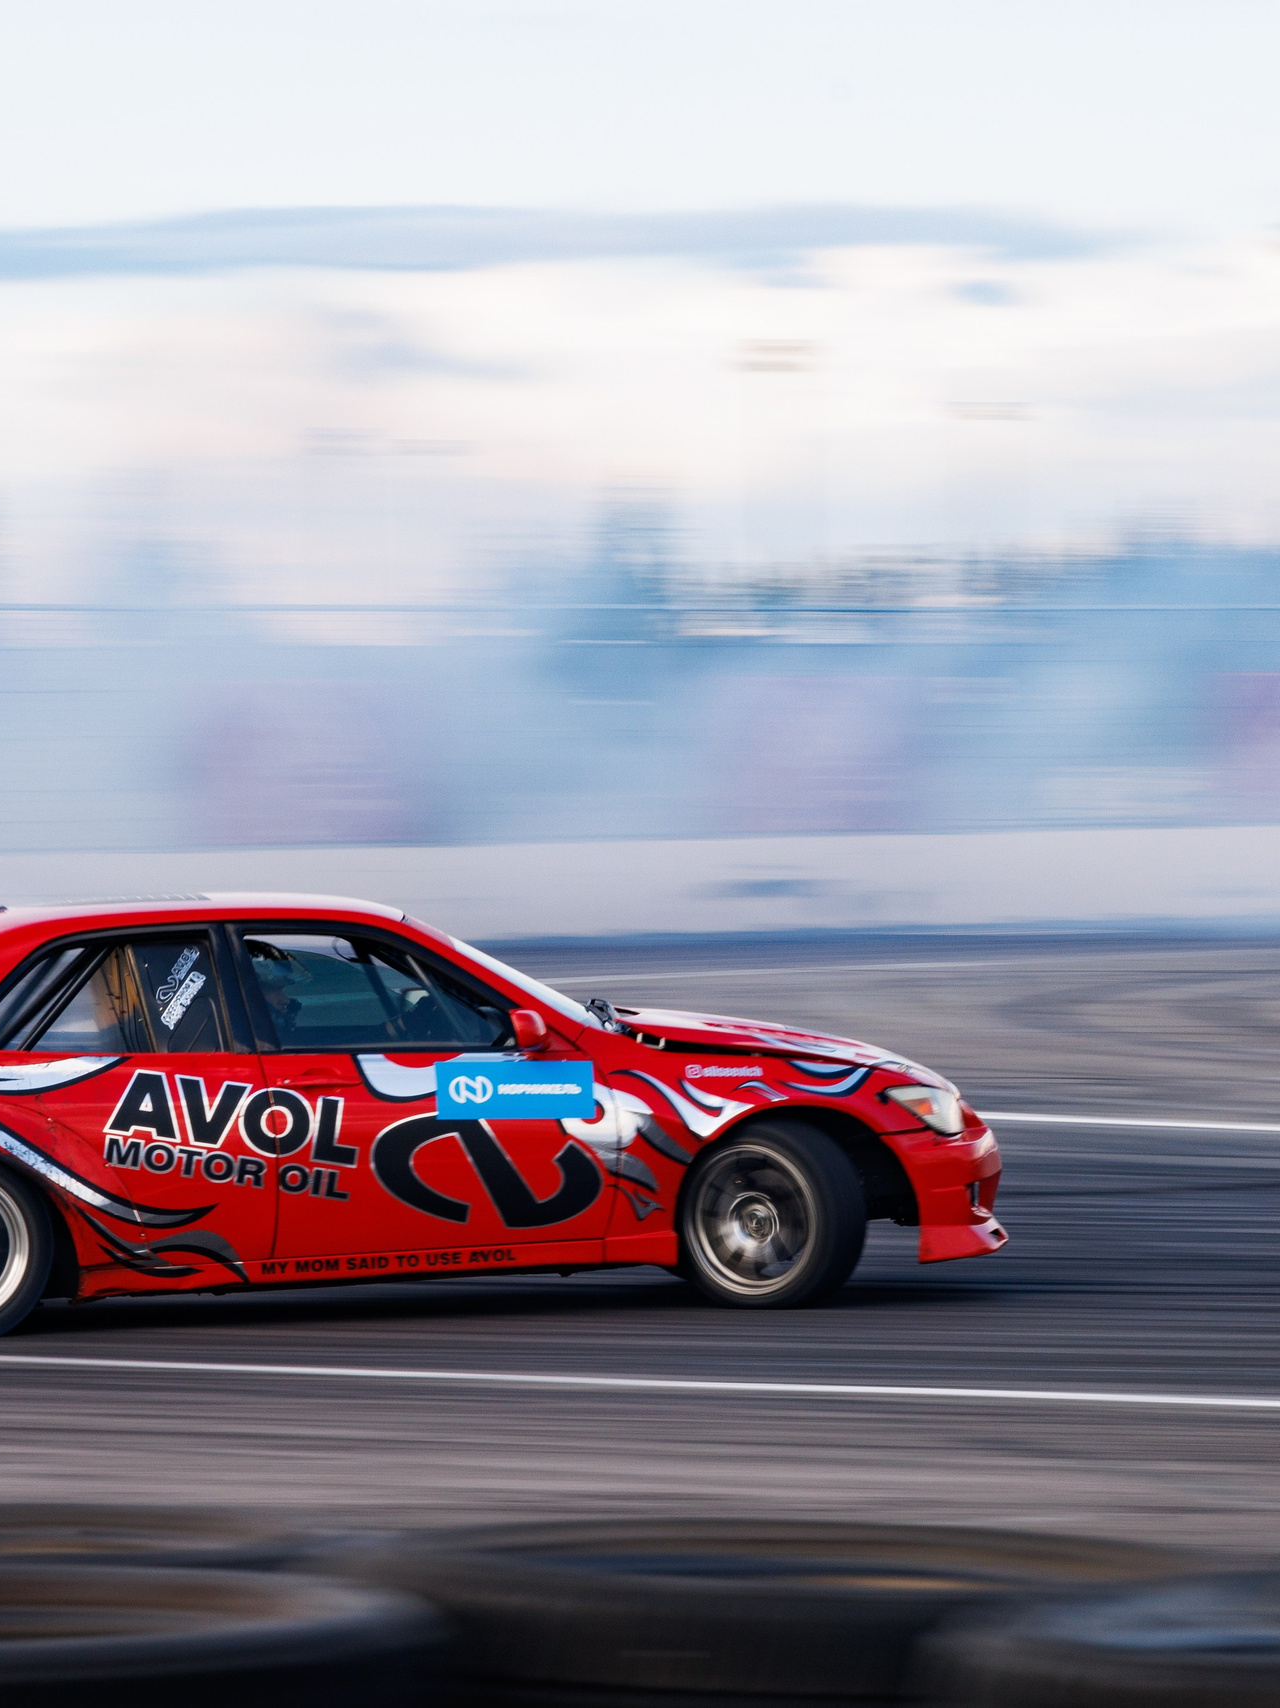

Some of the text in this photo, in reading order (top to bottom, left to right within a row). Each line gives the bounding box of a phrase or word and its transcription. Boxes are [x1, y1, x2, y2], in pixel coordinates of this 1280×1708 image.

[171, 947, 198, 977] AVOL
[103, 1069, 360, 1169] AVOL
[103, 1134, 351, 1202] MOTOR OIL
[261, 1248, 516, 1274] MY MOM SAID TO USE AVOL
